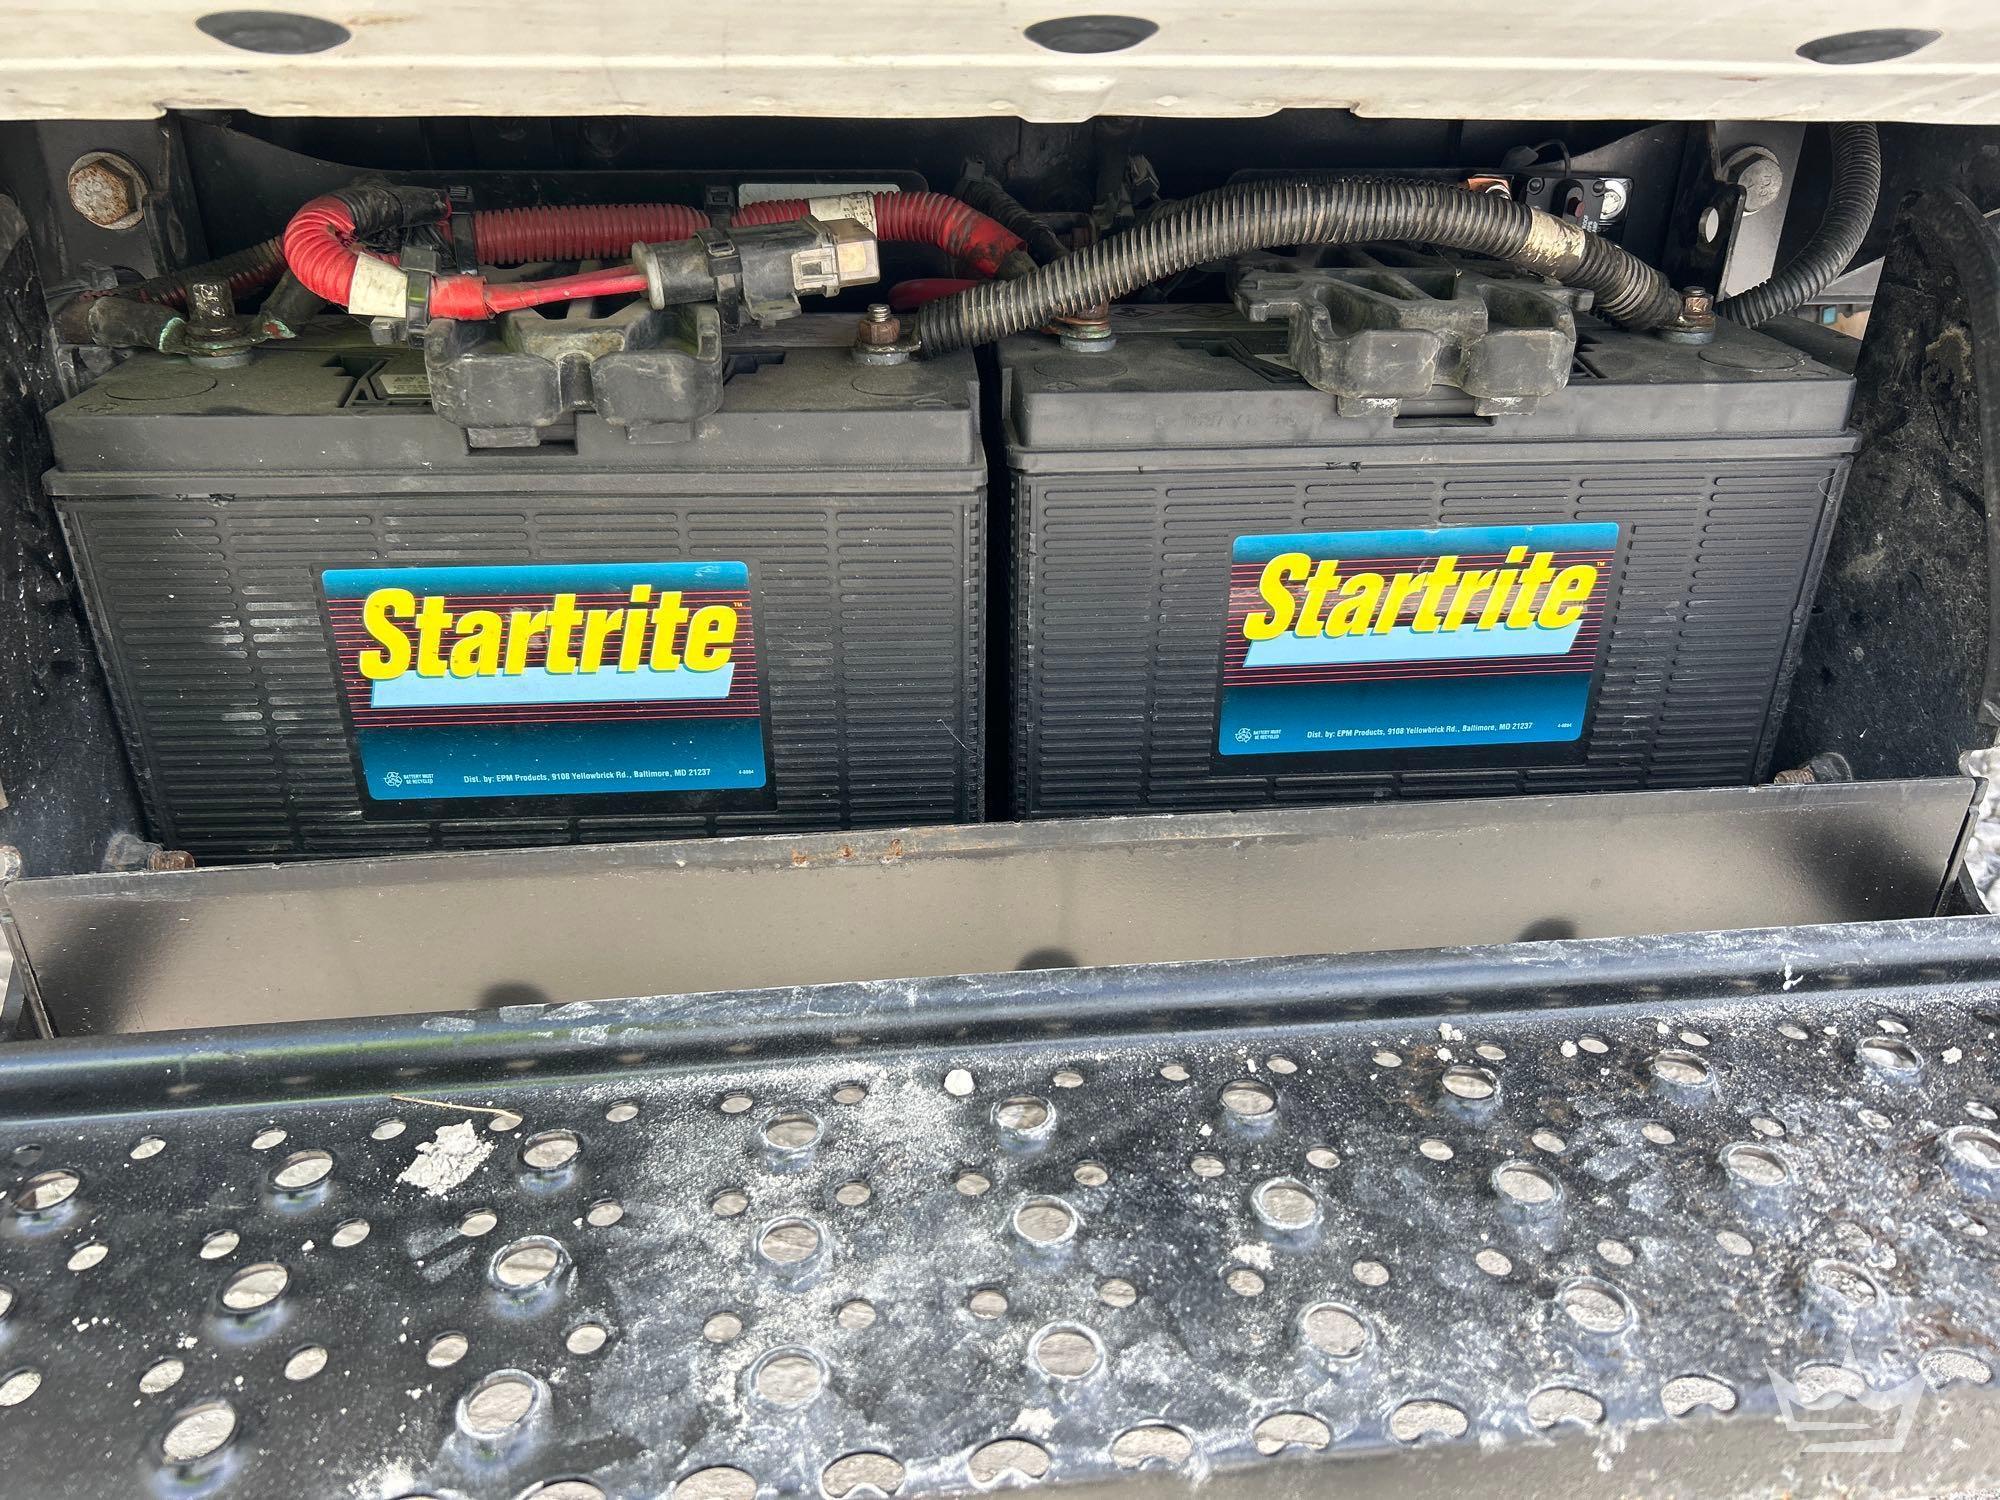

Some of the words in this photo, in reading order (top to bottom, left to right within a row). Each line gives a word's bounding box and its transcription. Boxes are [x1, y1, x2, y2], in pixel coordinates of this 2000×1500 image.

[1243, 545, 1598, 641] Startrite
[359, 584, 738, 680] Startrite
[1307, 730, 1323, 738] Dist.
[1325, 731, 1335, 739] by:
[1337, 729, 1353, 737] EPM
[1353, 728, 1385, 736] Products,
[1387, 727, 1405, 735] 9108
[1406, 726, 1445, 734] Yellowbrick
[1445, 725, 1460, 733] Rd.,
[1462, 724, 1497, 732] Baltimore,
[1512, 722, 1534, 730] 21237
[463, 775, 481, 783] Dist.
[483, 775, 494, 783] by:
[496, 774, 514, 782] EPM
[515, 773, 550, 781] Products,
[551, 772, 570, 780] 9108
[571, 771, 615, 780] Yellowbrick
[615, 771, 632, 779] Rd.,
[633, 770, 673, 778] Baltimore,
[674, 769, 687, 777] MD
[688, 768, 711, 776] 21237
